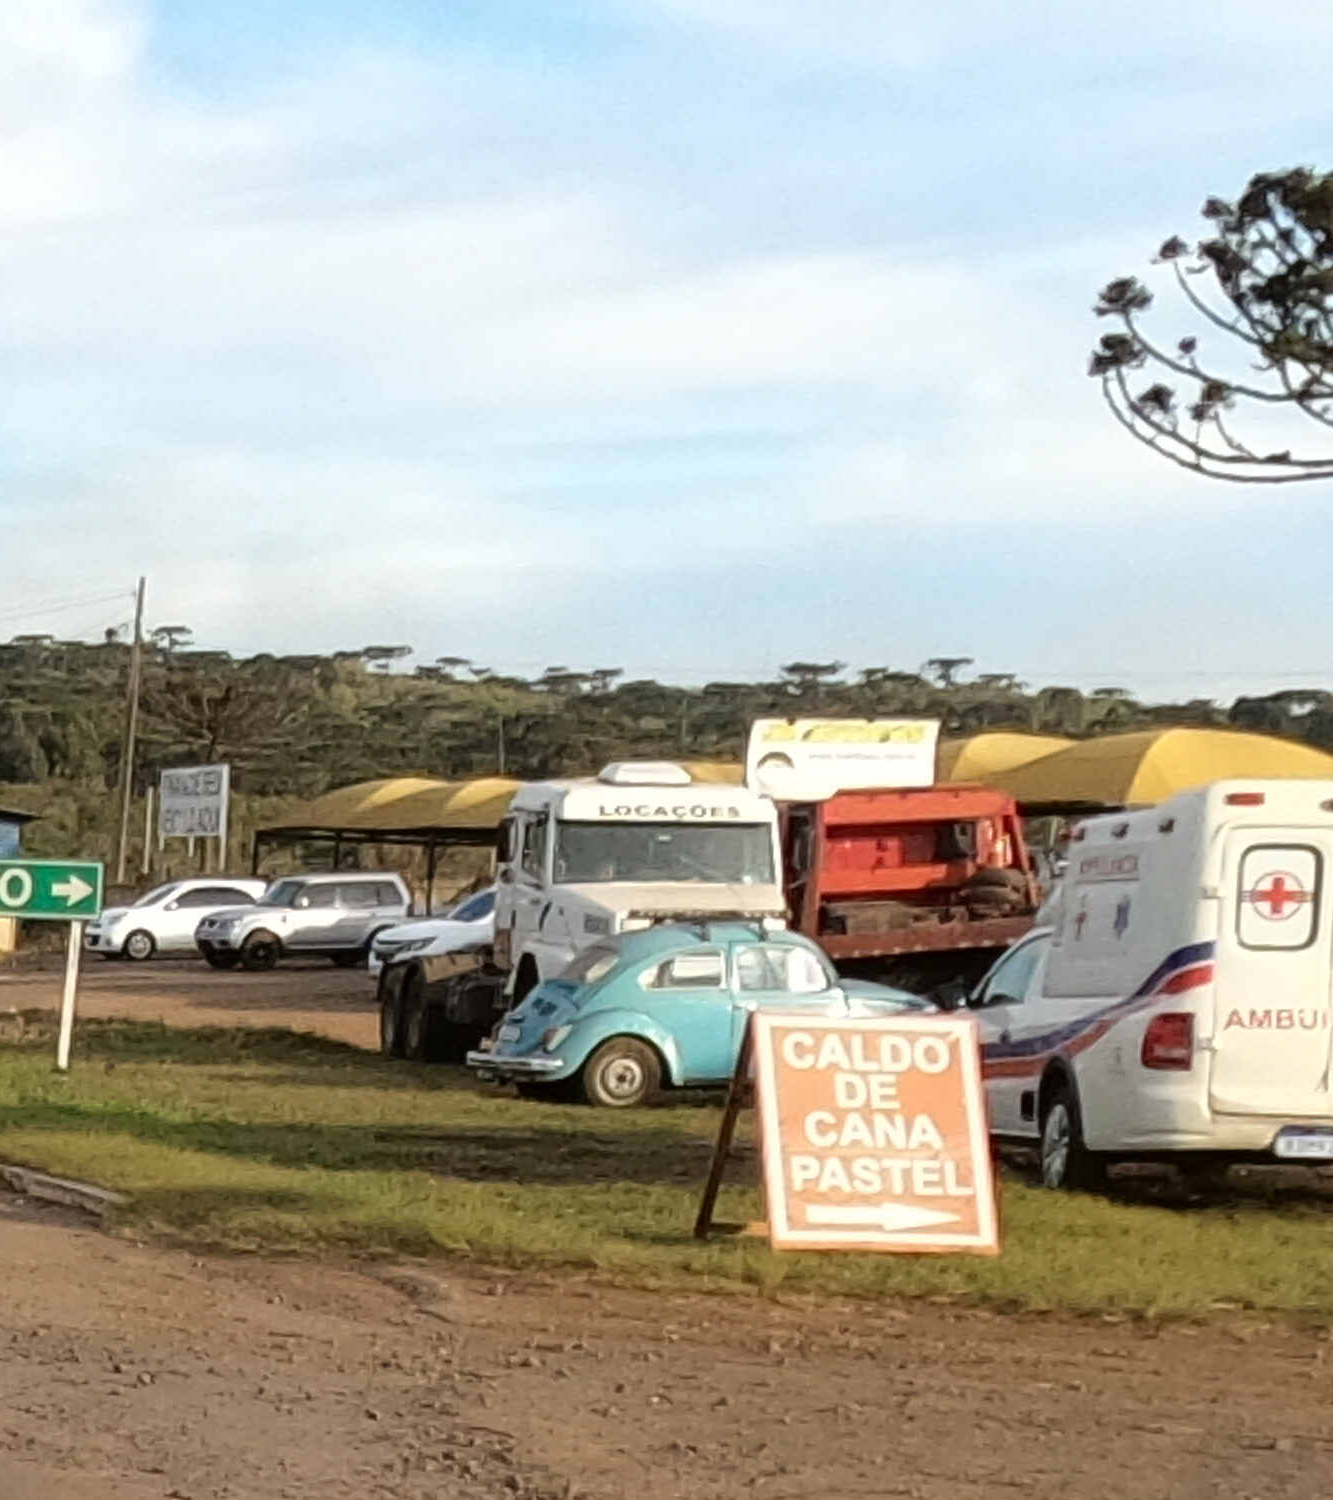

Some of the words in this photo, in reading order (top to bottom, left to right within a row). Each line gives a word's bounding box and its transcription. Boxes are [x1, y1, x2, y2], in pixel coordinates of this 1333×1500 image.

[782, 1032, 950, 1074] CALDO
[834, 1073, 901, 1110] DE
[804, 1111, 943, 1150] CANA
[789, 1154, 975, 1197] PASTEL
